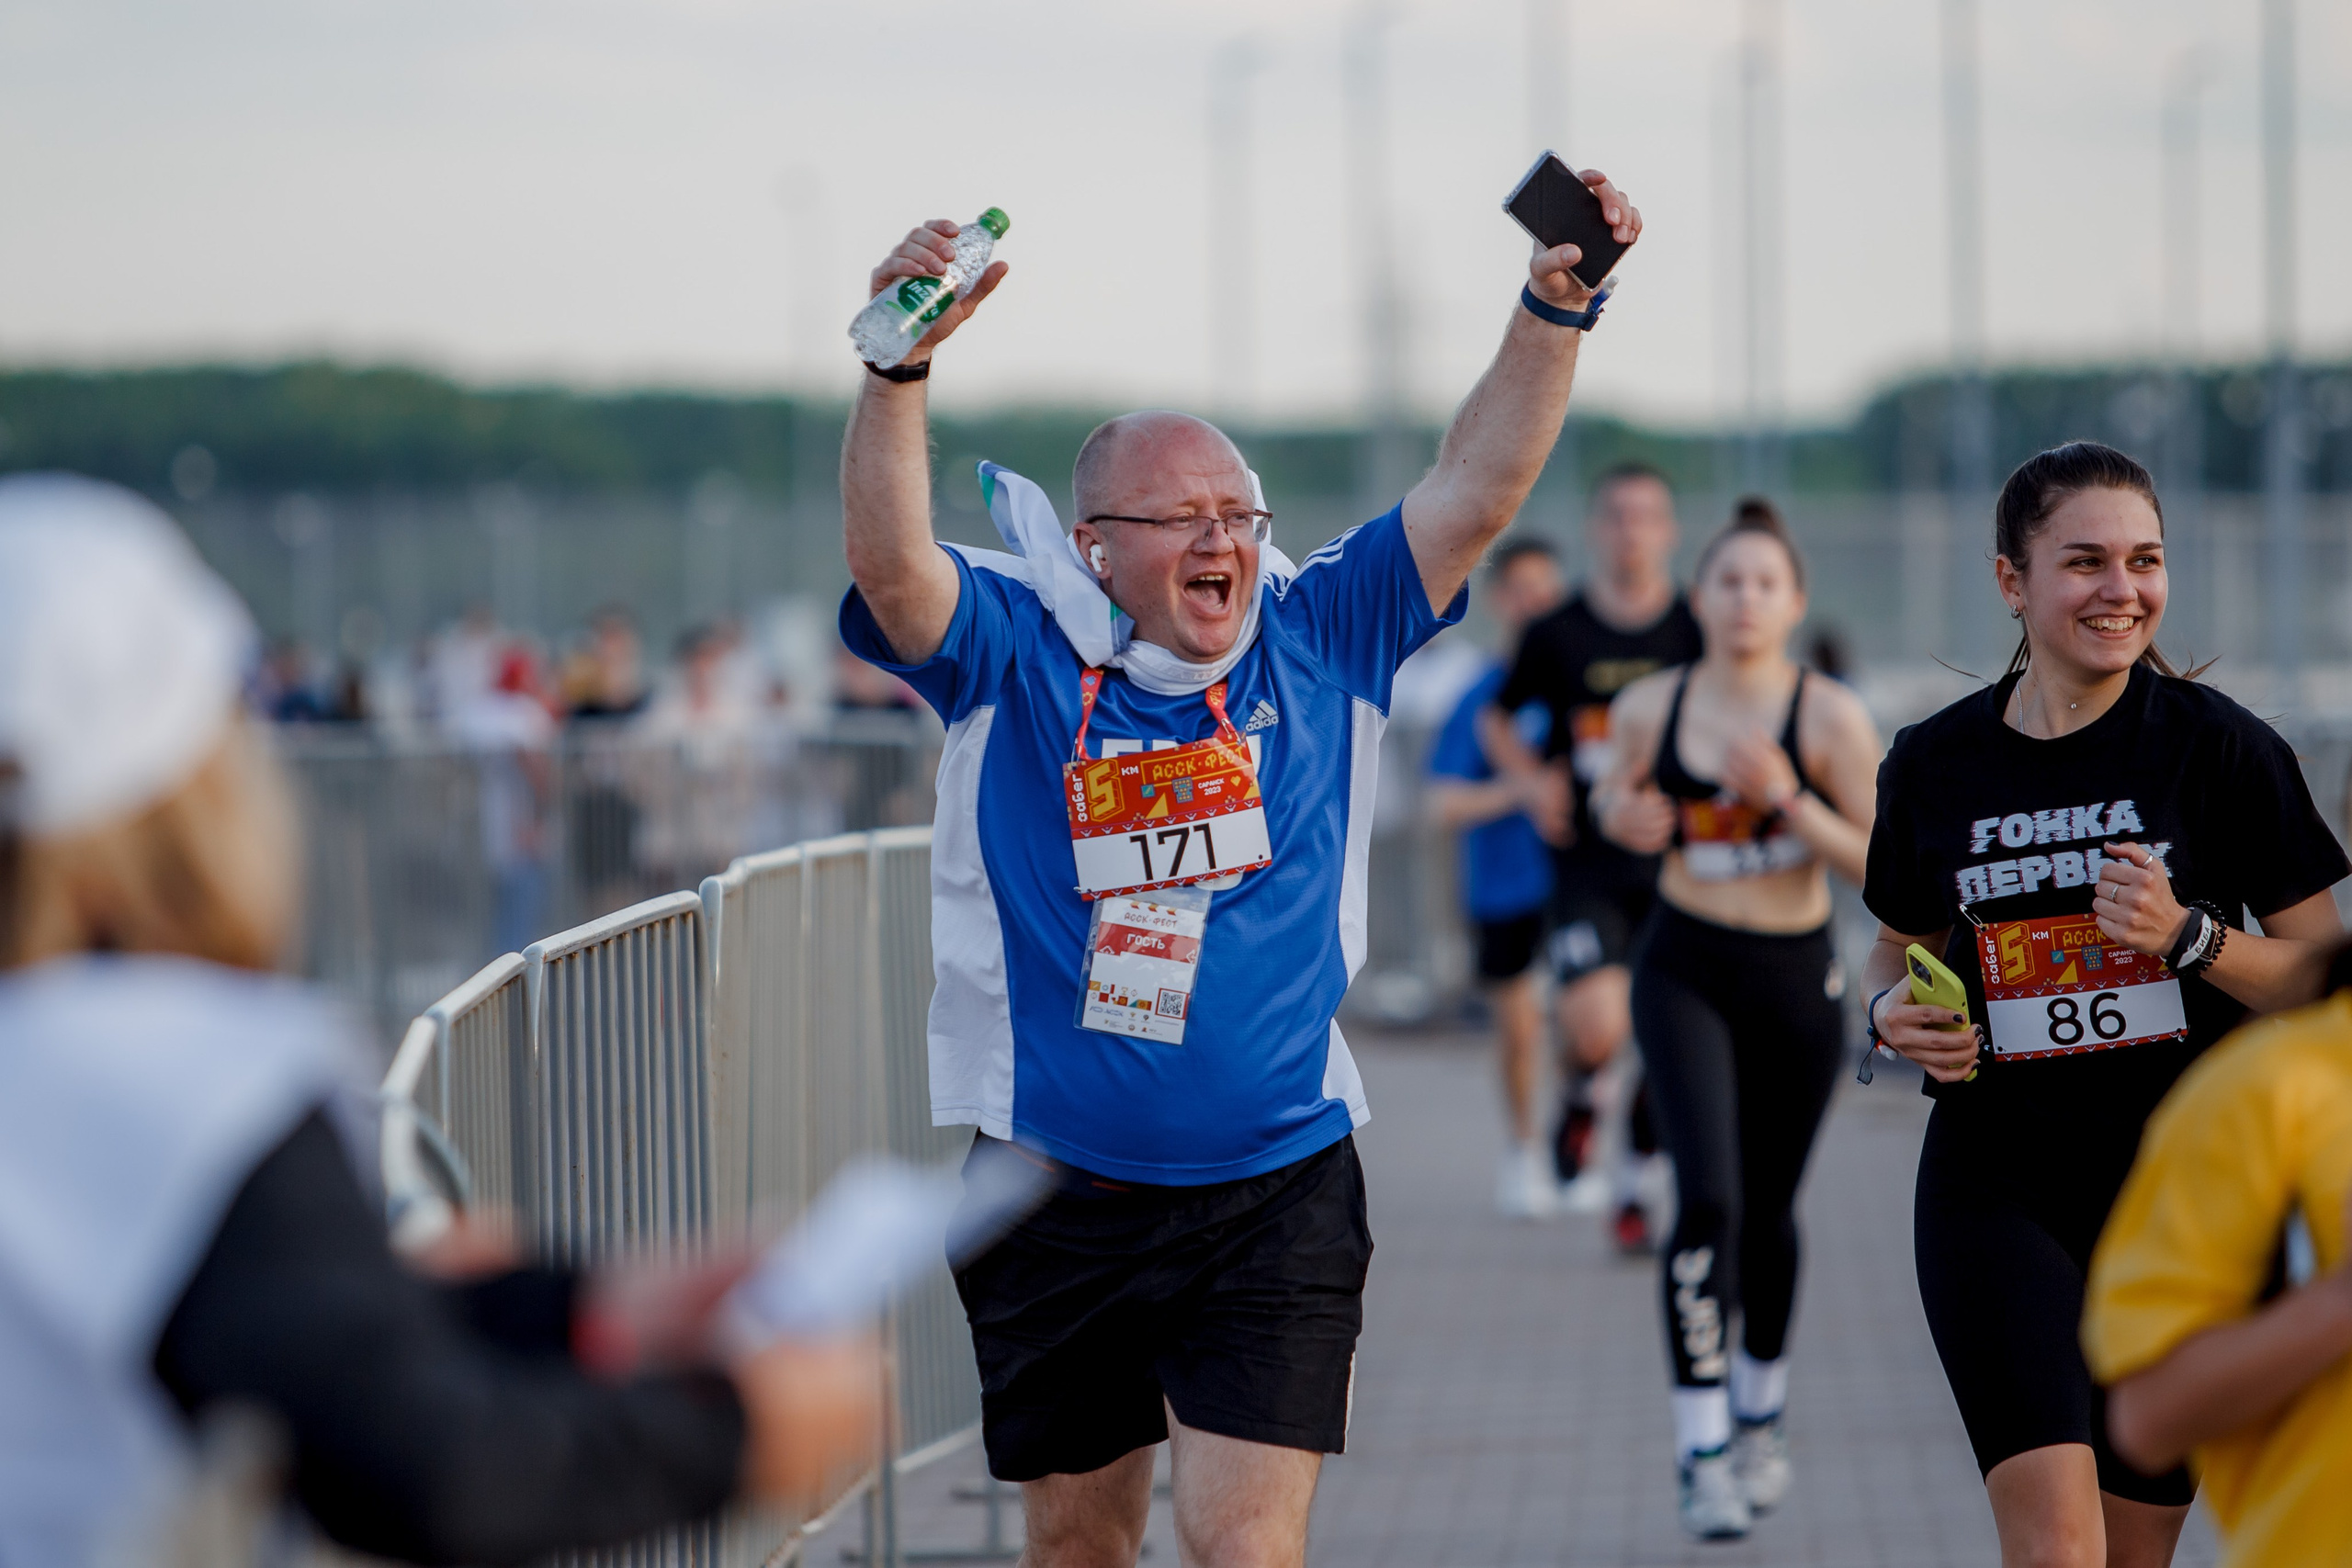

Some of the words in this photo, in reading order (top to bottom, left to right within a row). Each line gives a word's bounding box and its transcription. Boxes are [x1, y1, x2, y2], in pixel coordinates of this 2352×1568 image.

[1208, 686, 1224, 706] ФЕС
[1246, 715, 1280, 732] adida
[1121, 765, 1139, 776] КМ
[1198, 778, 1225, 789] САРАНСК
[1204, 786, 1222, 795] 2023
[1969, 799, 2145, 855] ГОНКА
[1129, 823, 1217, 882] 171
[1126, 933, 1166, 950] ГОСТЬ
[2032, 931, 2049, 941] КМ
[2115, 956, 2133, 964] 2023
[2047, 992, 2127, 1045] 86
